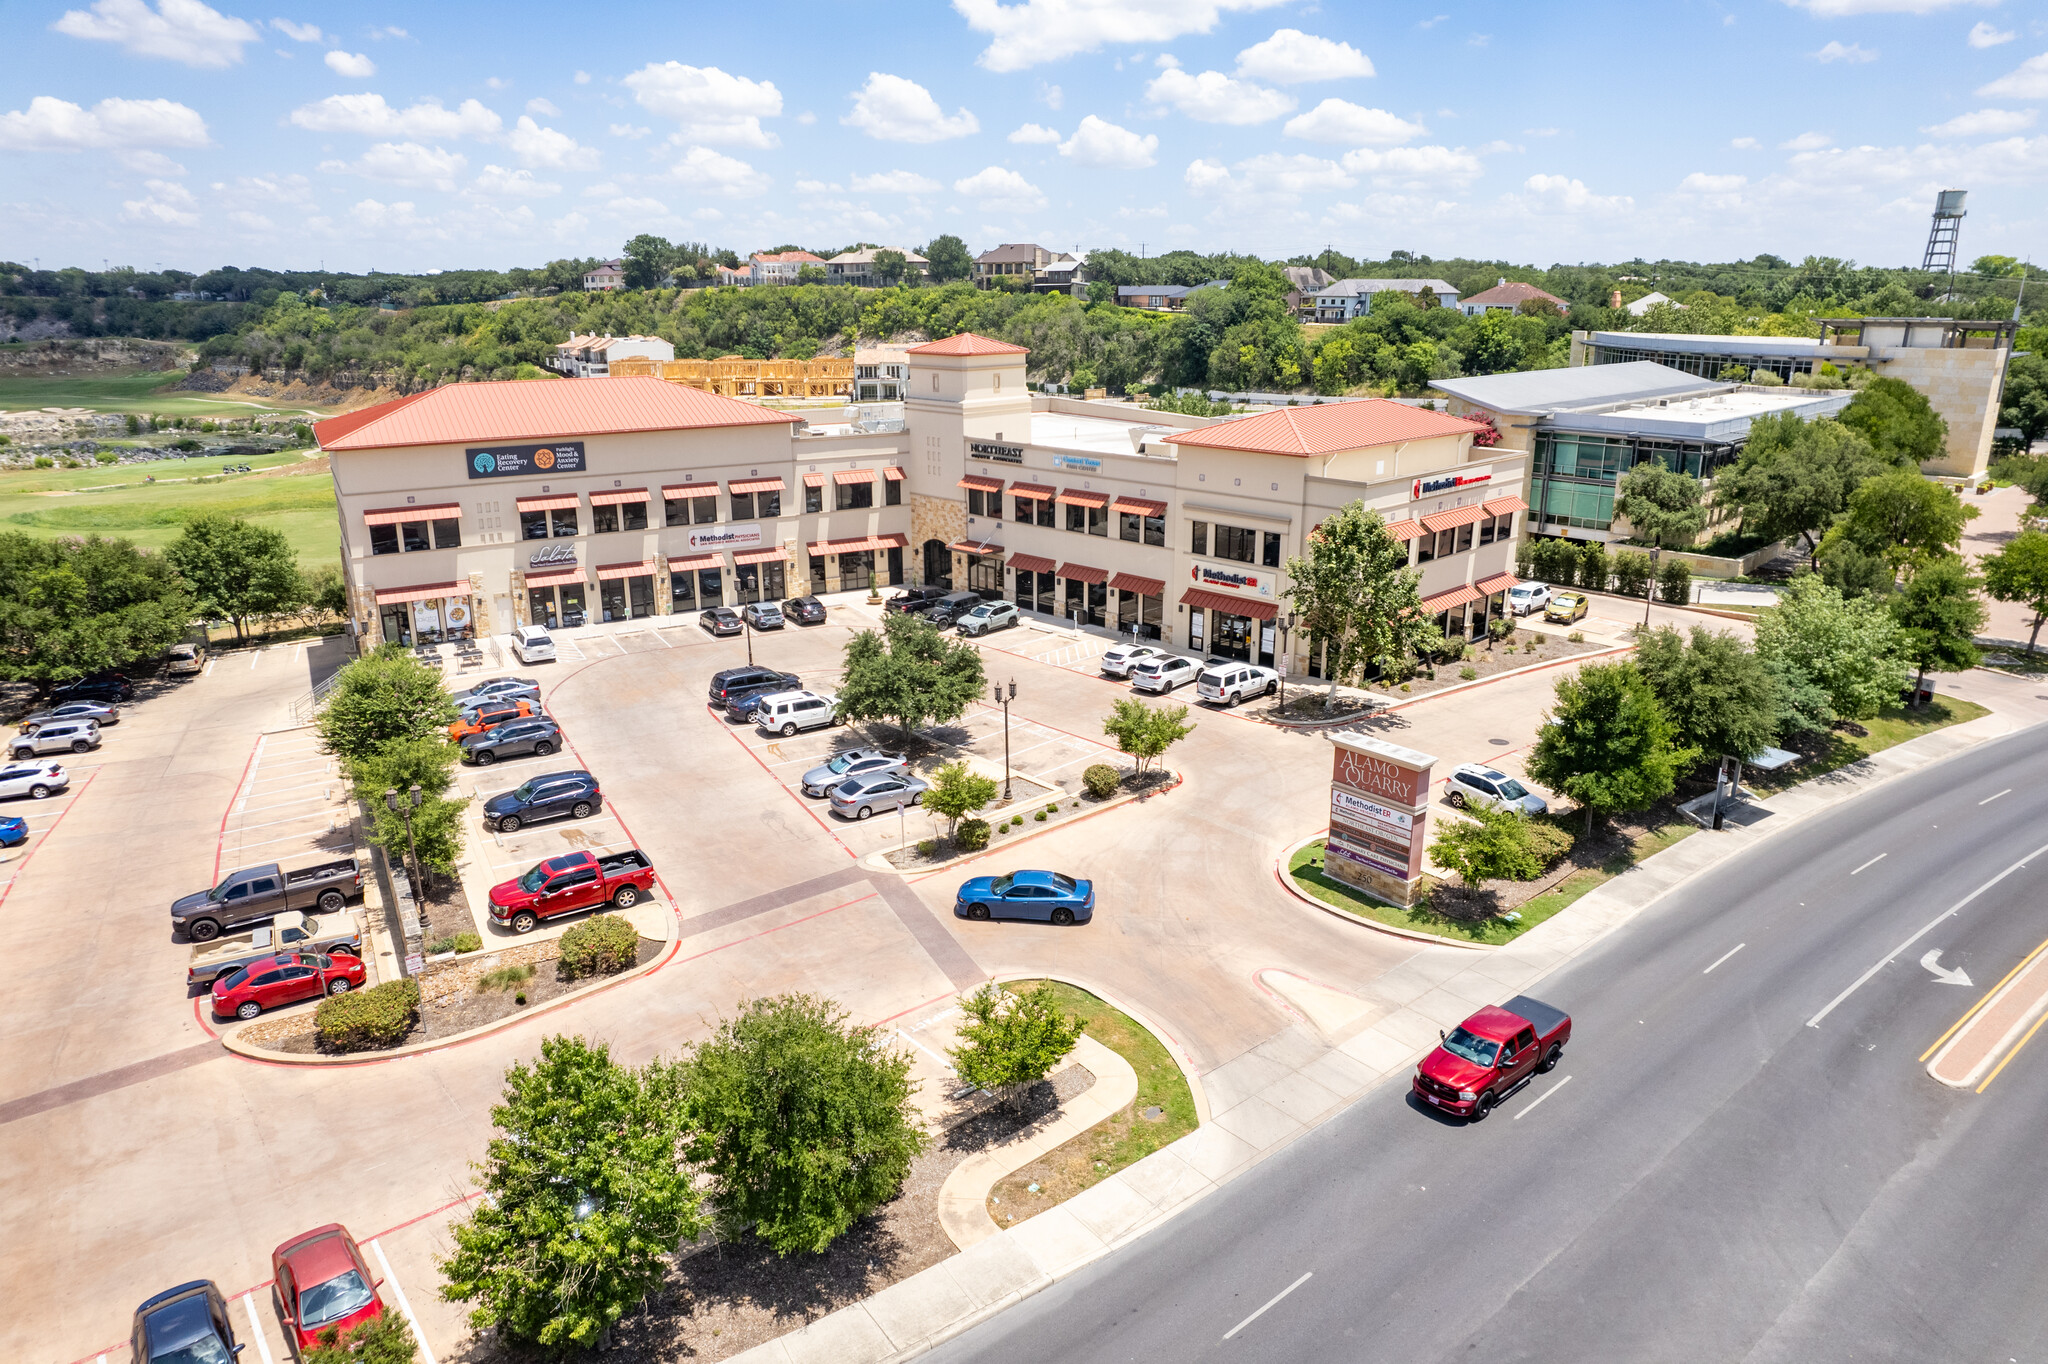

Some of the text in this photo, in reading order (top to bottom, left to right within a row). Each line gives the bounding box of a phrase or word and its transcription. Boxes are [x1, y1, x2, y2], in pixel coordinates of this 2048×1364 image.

[970, 443, 1023, 457] NORTHEAST
[700, 533, 734, 542] Methodist
[530, 544, 576, 562] Salata
[1203, 568, 1247, 585] Methodist
[1340, 750, 1399, 778] ALAMO
[1346, 766, 1411, 798] QUARRY
[1345, 796, 1382, 815] Methodist
[1342, 818, 1375, 833] NORTHEAST
[1346, 844, 1366, 855] PRIMARY
[1380, 856, 1406, 869] PHYSICIANS
[1358, 872, 1372, 884] 250
